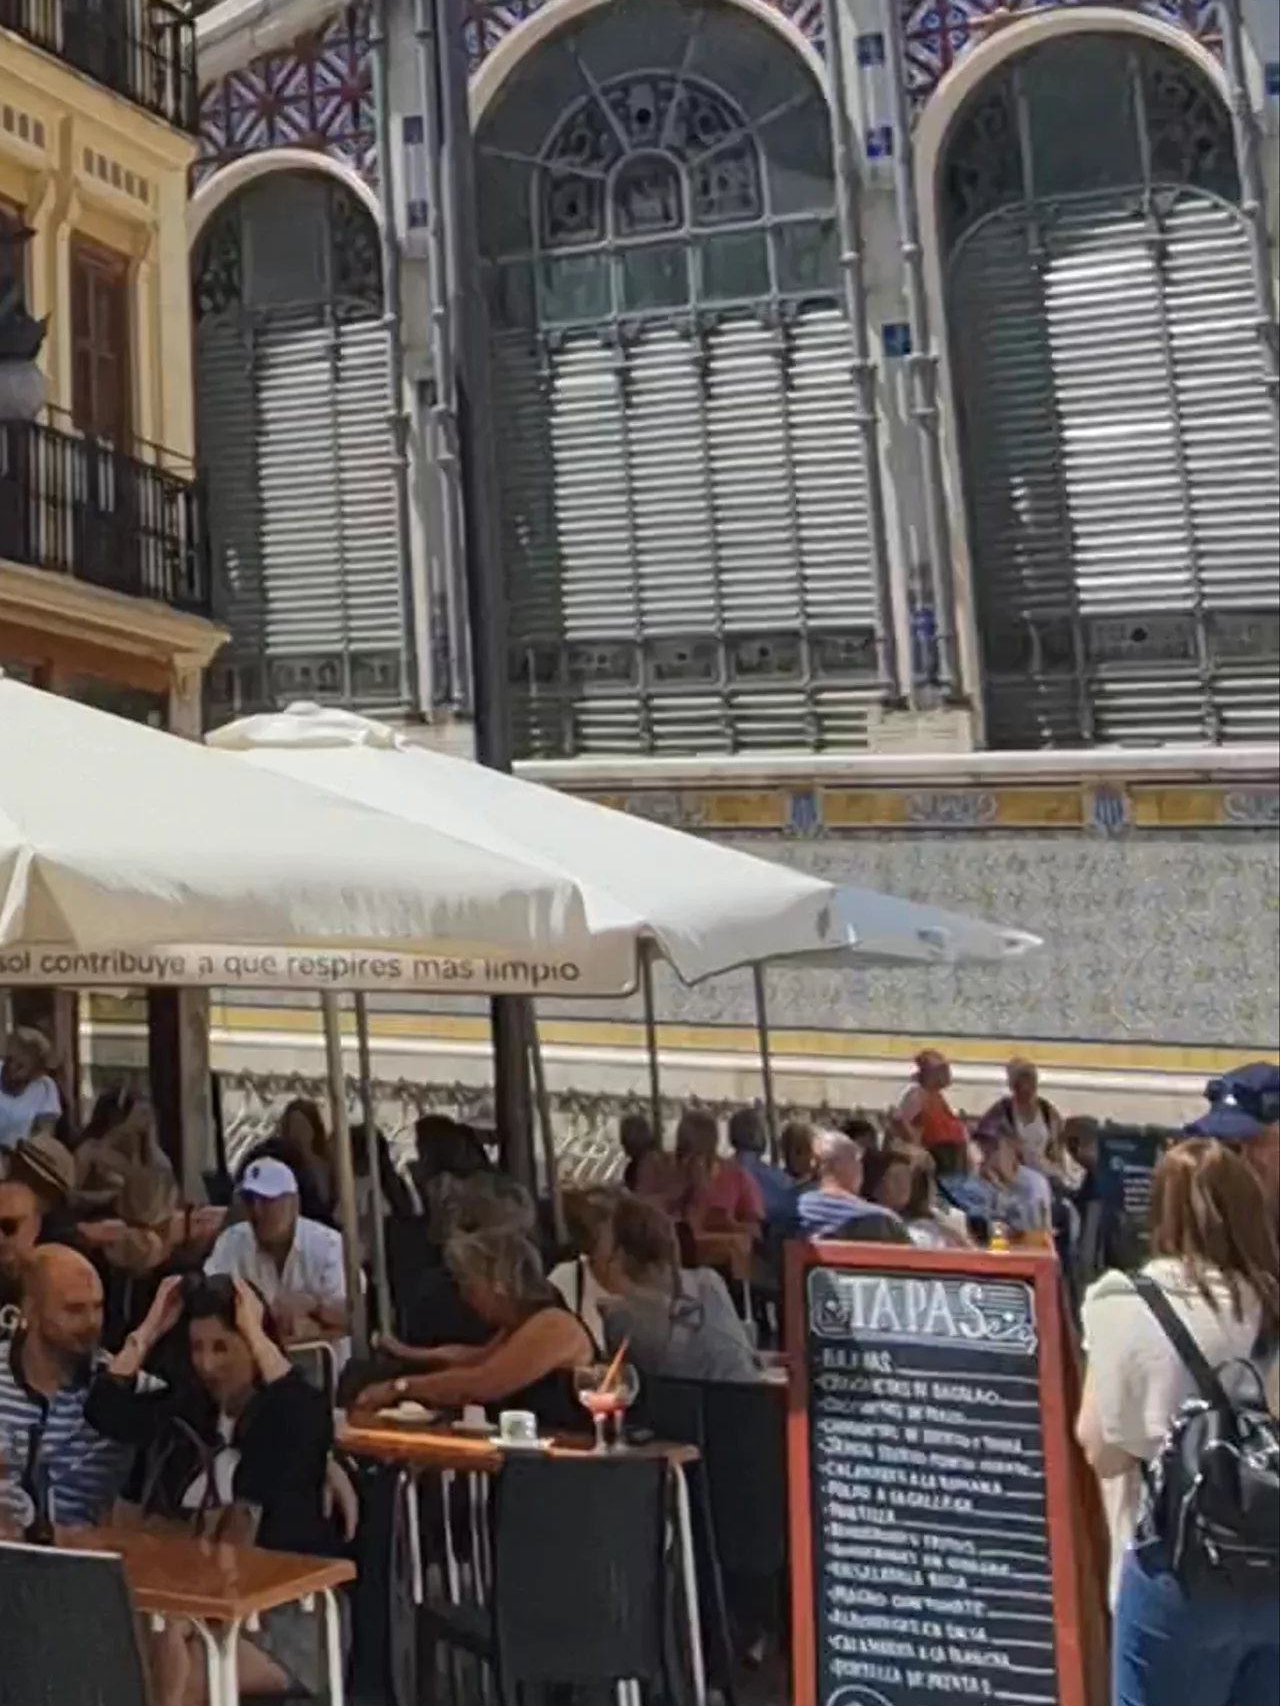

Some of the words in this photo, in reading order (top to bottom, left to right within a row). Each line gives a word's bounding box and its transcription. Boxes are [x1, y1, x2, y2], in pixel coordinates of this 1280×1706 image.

[40, 950, 186, 981] contribuye
[197, 954, 215, 978] a
[223, 953, 277, 982] que
[287, 952, 402, 981] respires
[483, 958, 582, 988] limpio
[839, 1276, 989, 1339] TAPAS
